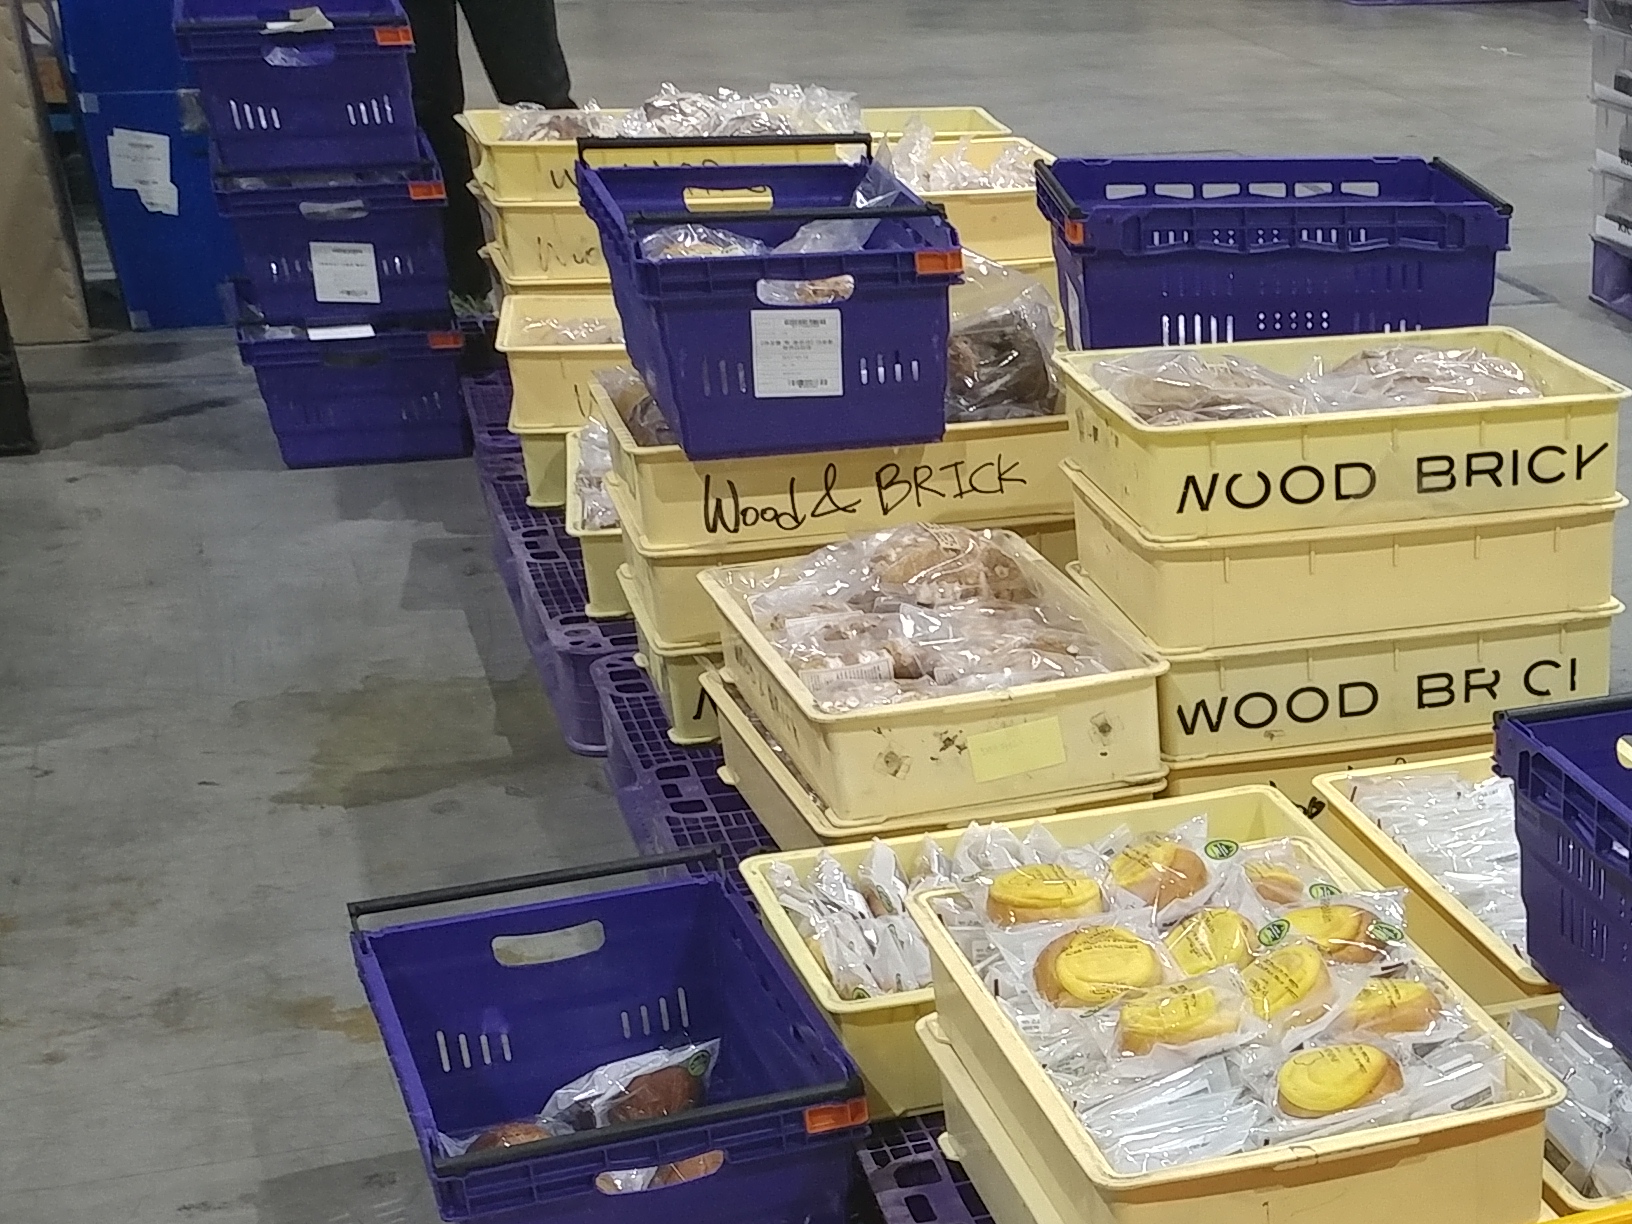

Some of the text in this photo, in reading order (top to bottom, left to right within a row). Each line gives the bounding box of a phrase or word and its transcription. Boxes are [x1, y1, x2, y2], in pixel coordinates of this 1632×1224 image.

[703, 453, 1027, 534] Wood & BRICK
[1177, 681, 1379, 736] WOOD
